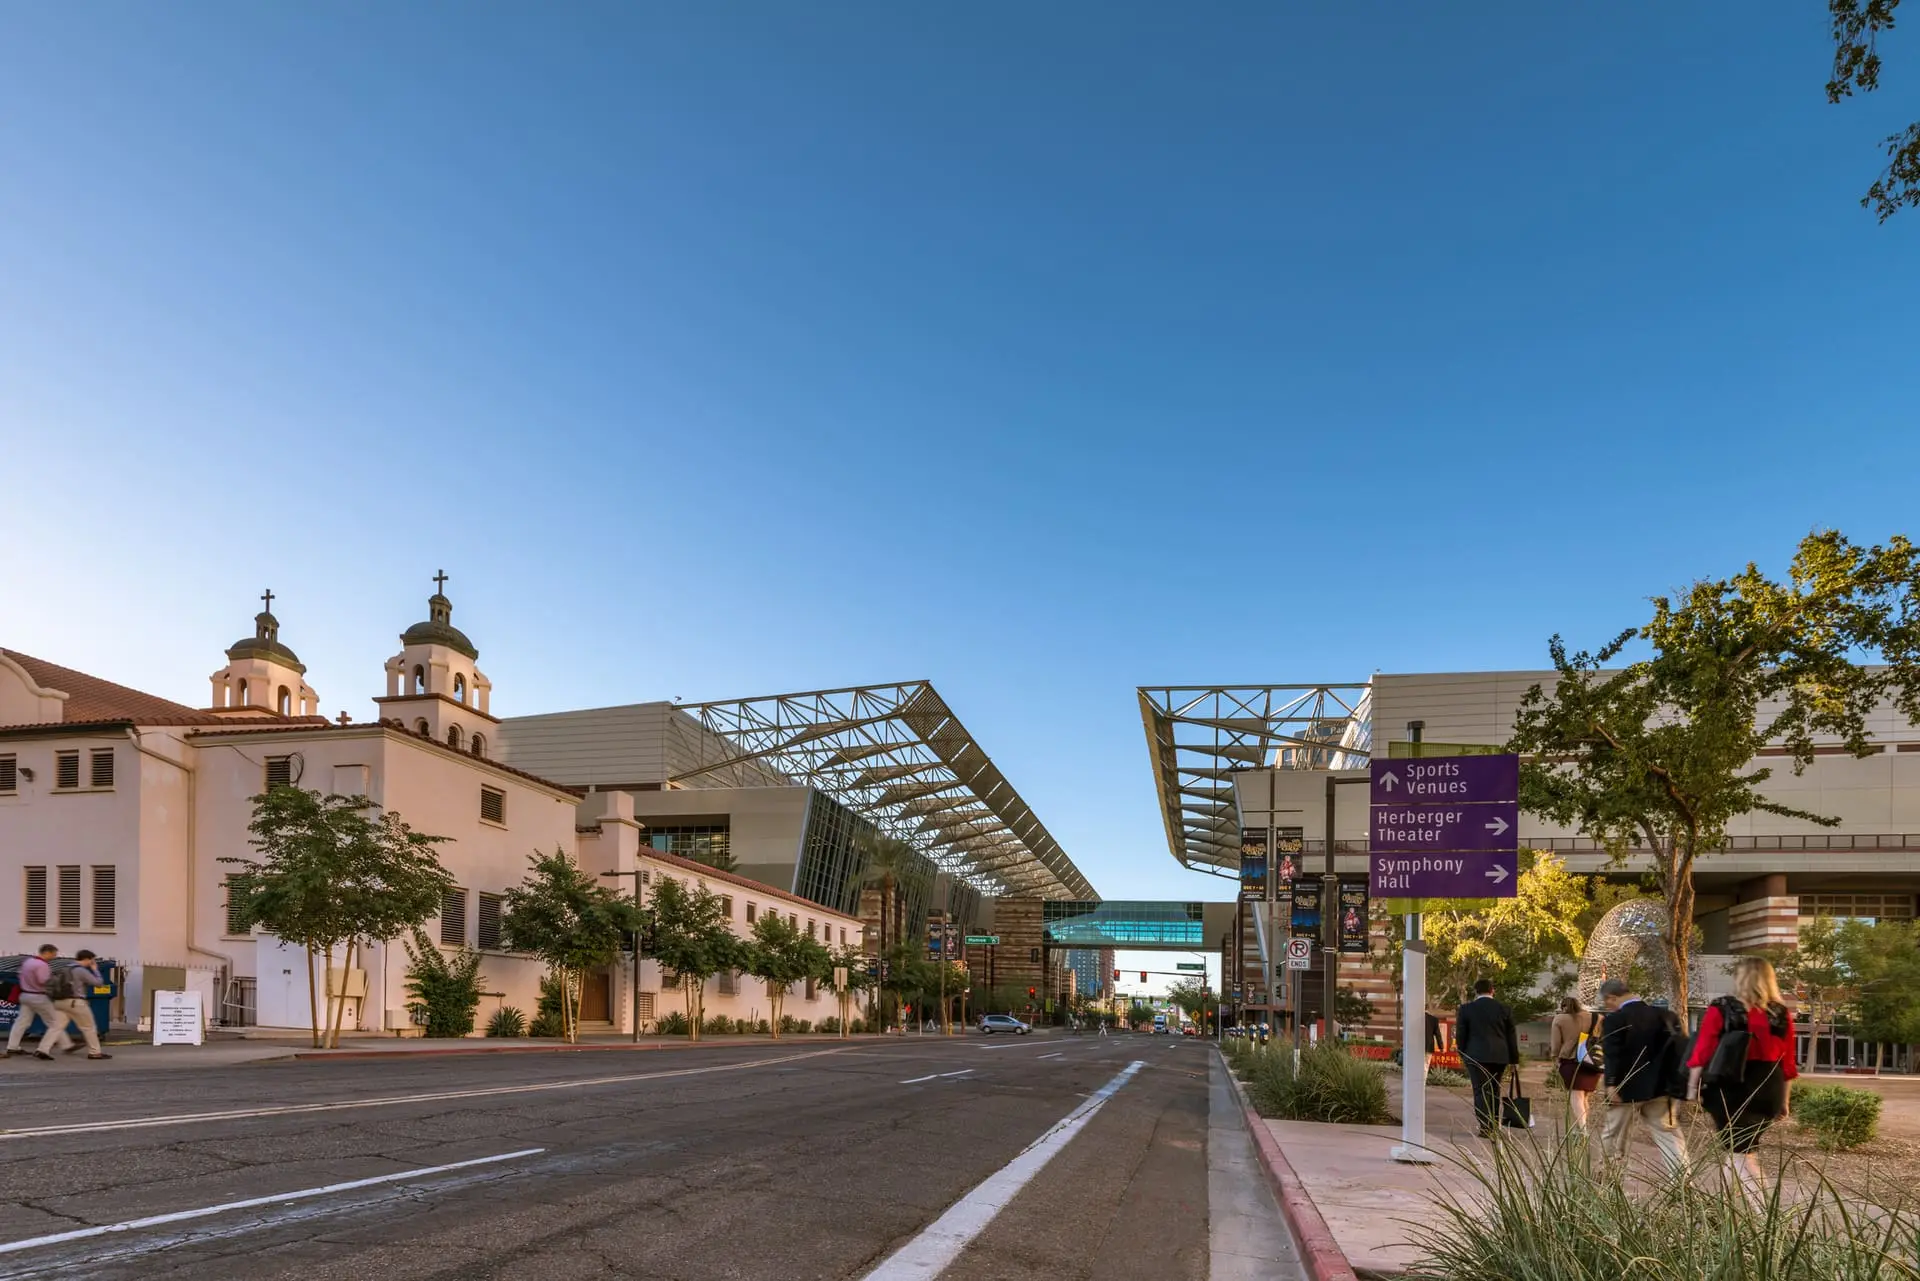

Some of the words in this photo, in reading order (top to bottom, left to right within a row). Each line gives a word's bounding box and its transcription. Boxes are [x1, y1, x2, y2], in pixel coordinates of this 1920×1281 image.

[1406, 762, 1460, 779] Sports
[1406, 781, 1468, 794] Venues
[1378, 811, 1463, 827] Herberger
[1378, 828, 1442, 841] Theater
[1378, 857, 1464, 875] Symphony
[1378, 874, 1410, 889] Hall
